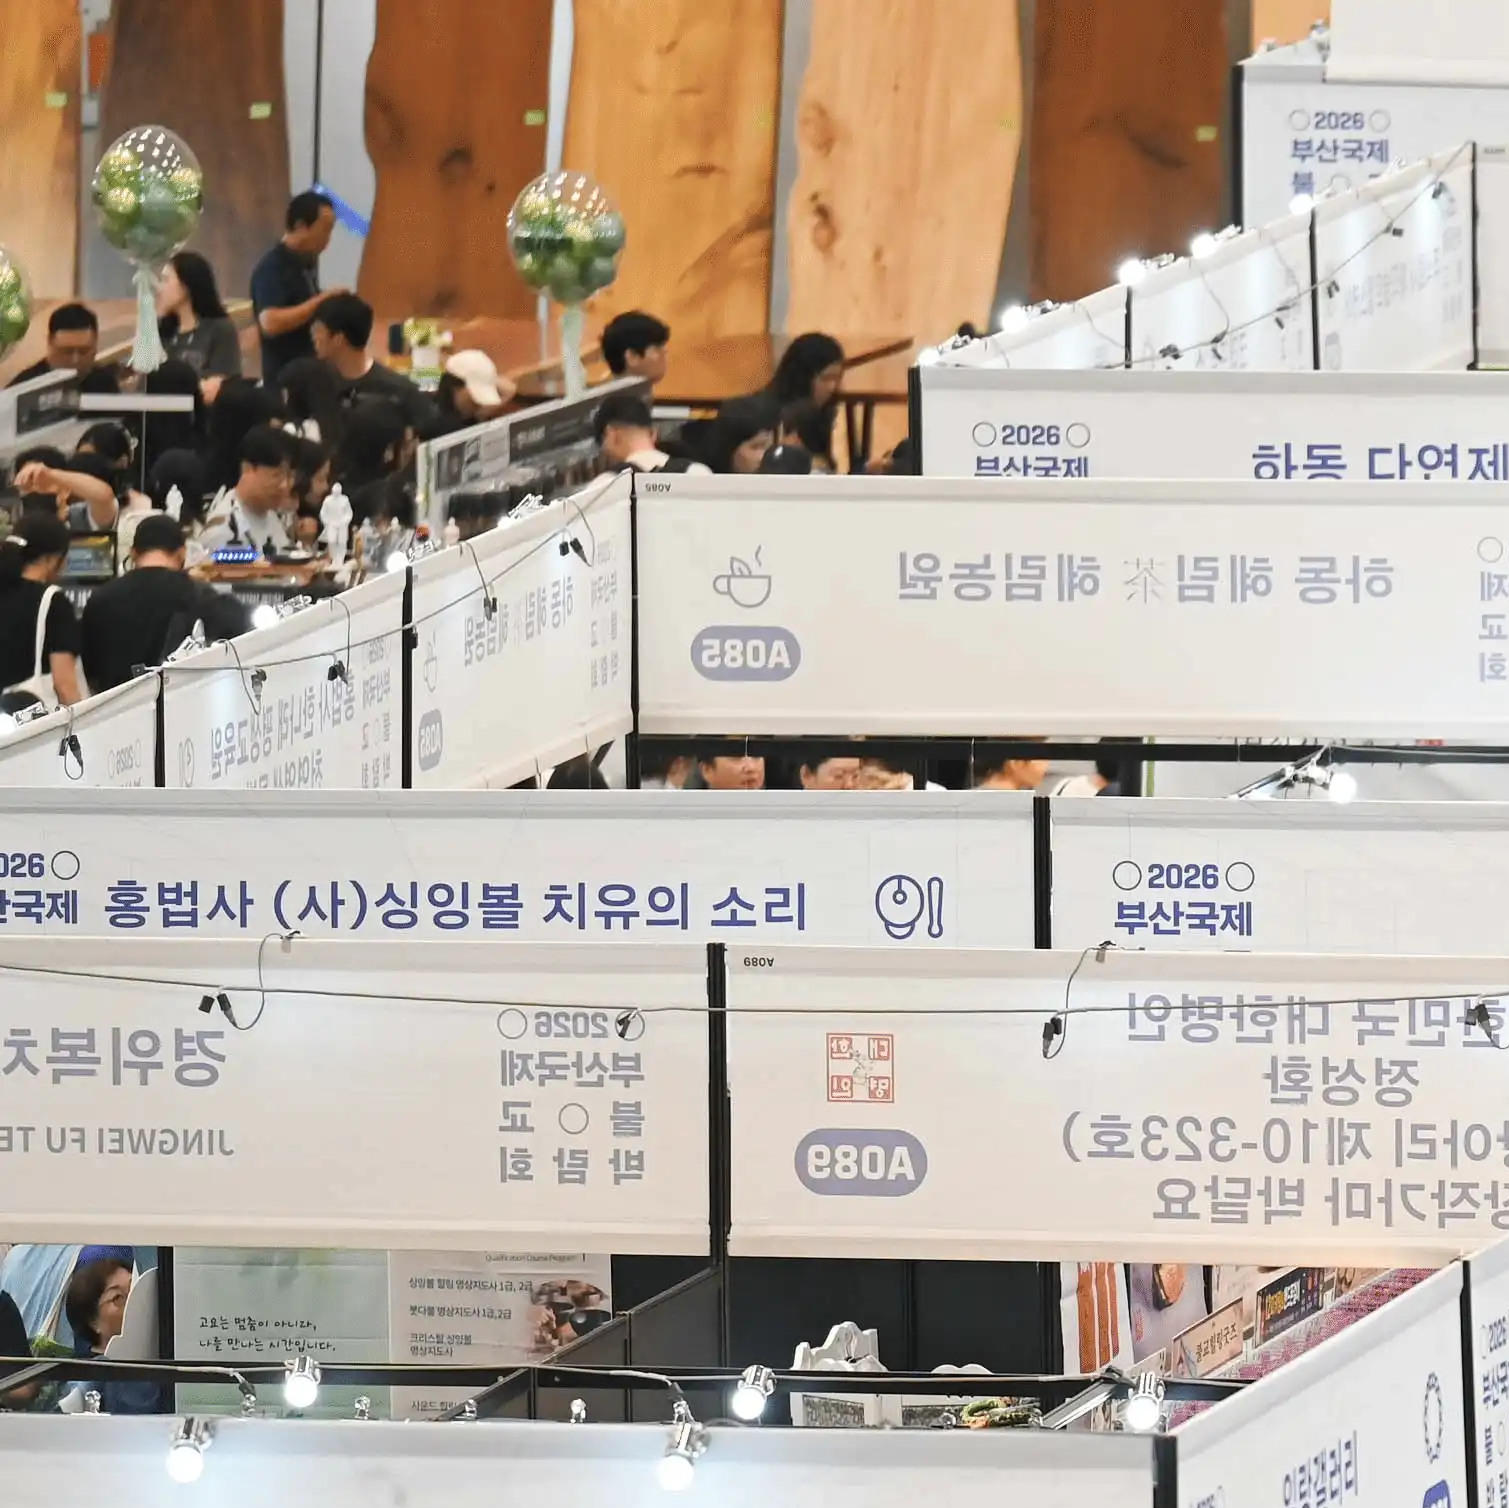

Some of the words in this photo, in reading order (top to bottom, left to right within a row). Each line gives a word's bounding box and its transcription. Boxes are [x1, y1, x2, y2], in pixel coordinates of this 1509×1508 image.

[1314, 111, 1365, 130] 2026
[1291, 138, 1389, 163] 부산국제
[1001, 424, 1061, 447] 2026
[1147, 863, 1219, 890] 2026
[104, 879, 255, 929] 홍법사
[273, 879, 524, 931] (사)싱잉볼
[542, 882, 689, 931] 치유의
[710, 882, 805, 931] 소리
[1114, 900, 1253, 937] 부산국제
